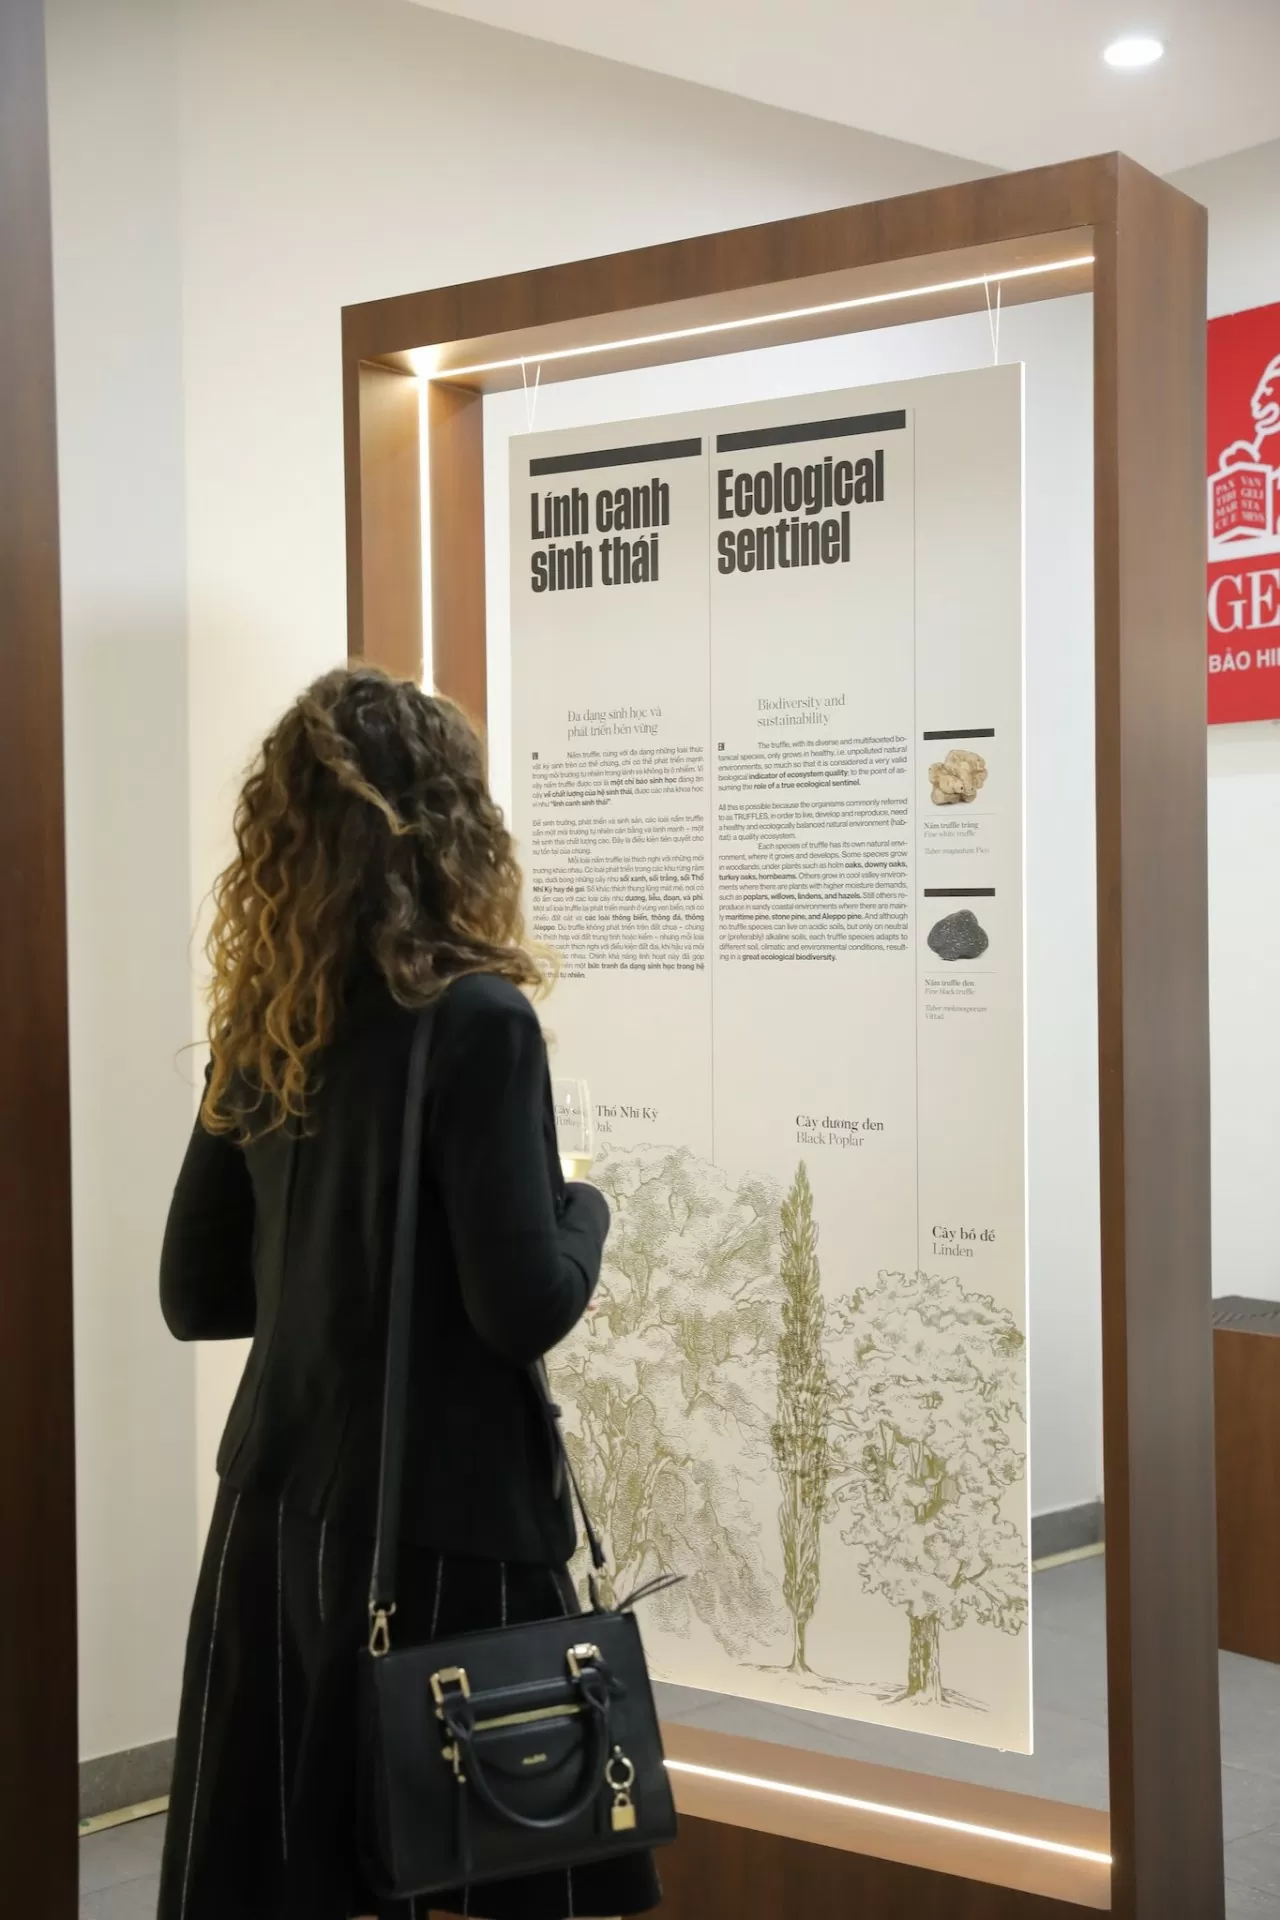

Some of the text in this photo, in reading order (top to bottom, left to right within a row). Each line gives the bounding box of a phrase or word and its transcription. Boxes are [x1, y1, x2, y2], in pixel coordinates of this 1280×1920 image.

[718, 449, 884, 519] Ecological
[531, 477, 670, 540] Lính canh
[718, 511, 850, 574] sentinel
[531, 533, 659, 593] sinh thái
[758, 693, 846, 711] Biodiversity and
[608, 707, 628, 719] sinh
[757, 712, 829, 726] sustainability
[758, 741, 770, 749] The
[815, 738, 839, 746] diverse
[853, 736, 895, 745] multifaceted
[718, 753, 739, 761] tanical
[767, 751, 781, 760] only
[782, 751, 802, 760] grows
[847, 747, 882, 757] unpolluted
[884, 746, 907, 754] natural
[773, 761, 792, 769] much
[803, 760, 816, 768] that
[830, 758, 867, 767] considered
[875, 758, 890, 766] very
[718, 773, 748, 782] biological
[749, 772, 778, 780] indicator
[787, 770, 824, 780] ecosystem
[859, 768, 869, 776] the
[870, 768, 887, 777] point
[718, 783, 741, 792] suming
[742, 782, 752, 790] the
[754, 782, 767, 790] role
[781, 781, 795, 789] true
[796, 780, 831, 790] ecological
[761, 862, 780, 870] under
[781, 862, 801, 871] plants
[864, 861, 887, 870] downy
[799, 872, 821, 880] Others
[822, 873, 838, 881] grow
[861, 871, 880, 880] valley
[881, 871, 908, 879] environ-
[719, 893, 734, 901] such
[824, 892, 837, 900] and
[742, 953, 760, 962] great
[761, 953, 795, 962] ecological
[601, 962, 618, 970] tranh
[676, 962, 695, 971] trong
[796, 1115, 819, 1131] Cây
[796, 1131, 864, 1148] Black Poplar
[933, 1225, 957, 1242] Cây
[933, 1242, 974, 1257] Linden
